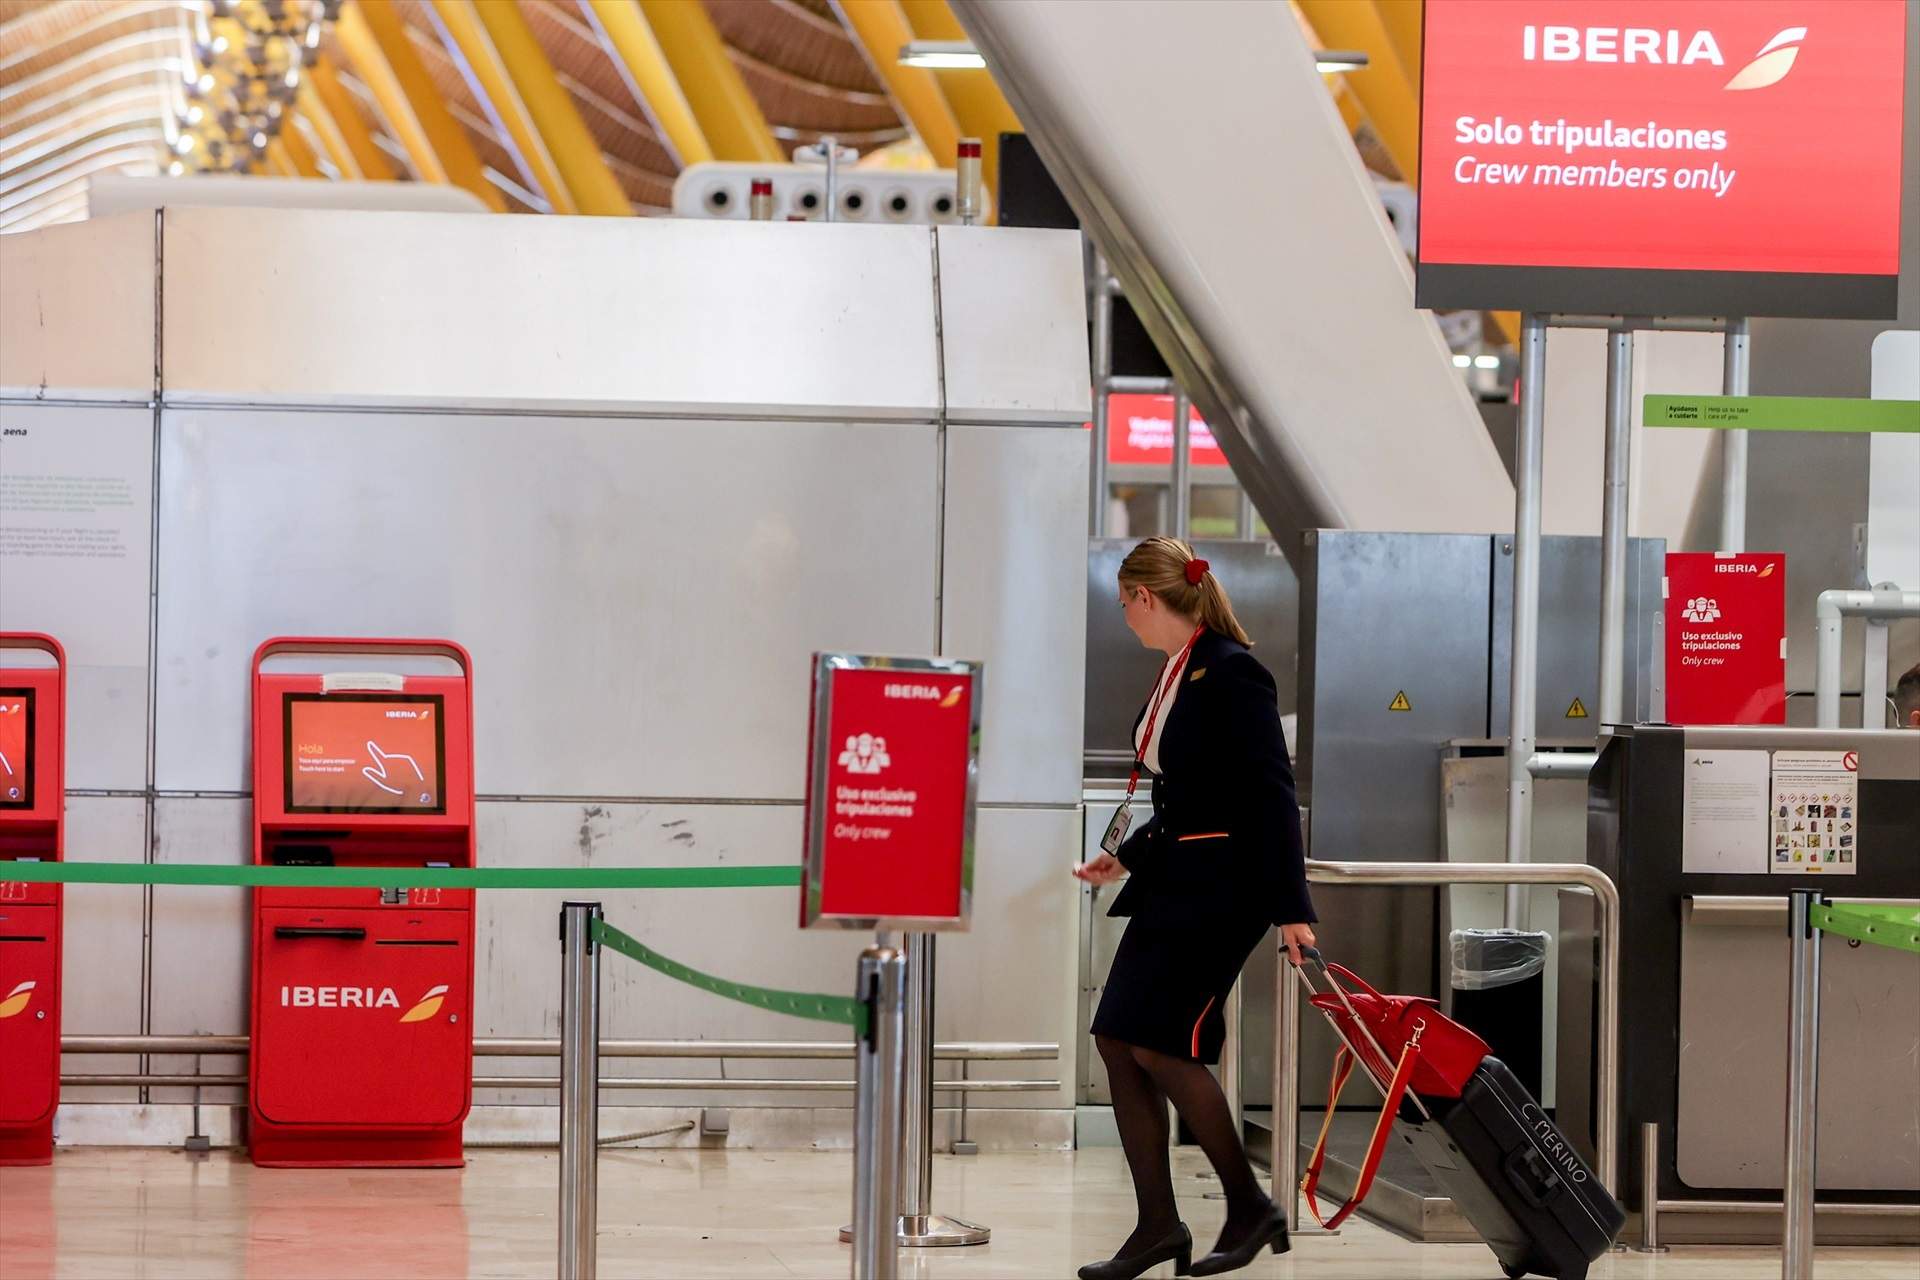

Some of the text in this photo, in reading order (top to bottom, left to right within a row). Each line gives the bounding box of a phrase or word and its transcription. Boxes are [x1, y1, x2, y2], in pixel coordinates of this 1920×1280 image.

[1522, 25, 1725, 66] IBERIA
[1455, 116, 1728, 154] Solo tripulaciones
[1453, 155, 1736, 198] Crew members only
[3, 427, 28, 436] aena
[1714, 564, 1758, 574] IBERIA
[1681, 631, 1743, 641] Uso exclusivo
[1681, 641, 1741, 652] tripulaciones
[1681, 656, 1725, 667] Only crew
[884, 684, 941, 699] IBERIA
[298, 744, 323, 754] Hola
[836, 785, 917, 802] Uso exclusivo
[835, 801, 914, 818] tripulaciones
[833, 823, 892, 841] Only crew
[281, 986, 400, 1008] IBERIA
[1535, 1120, 1587, 1183] MERINO
